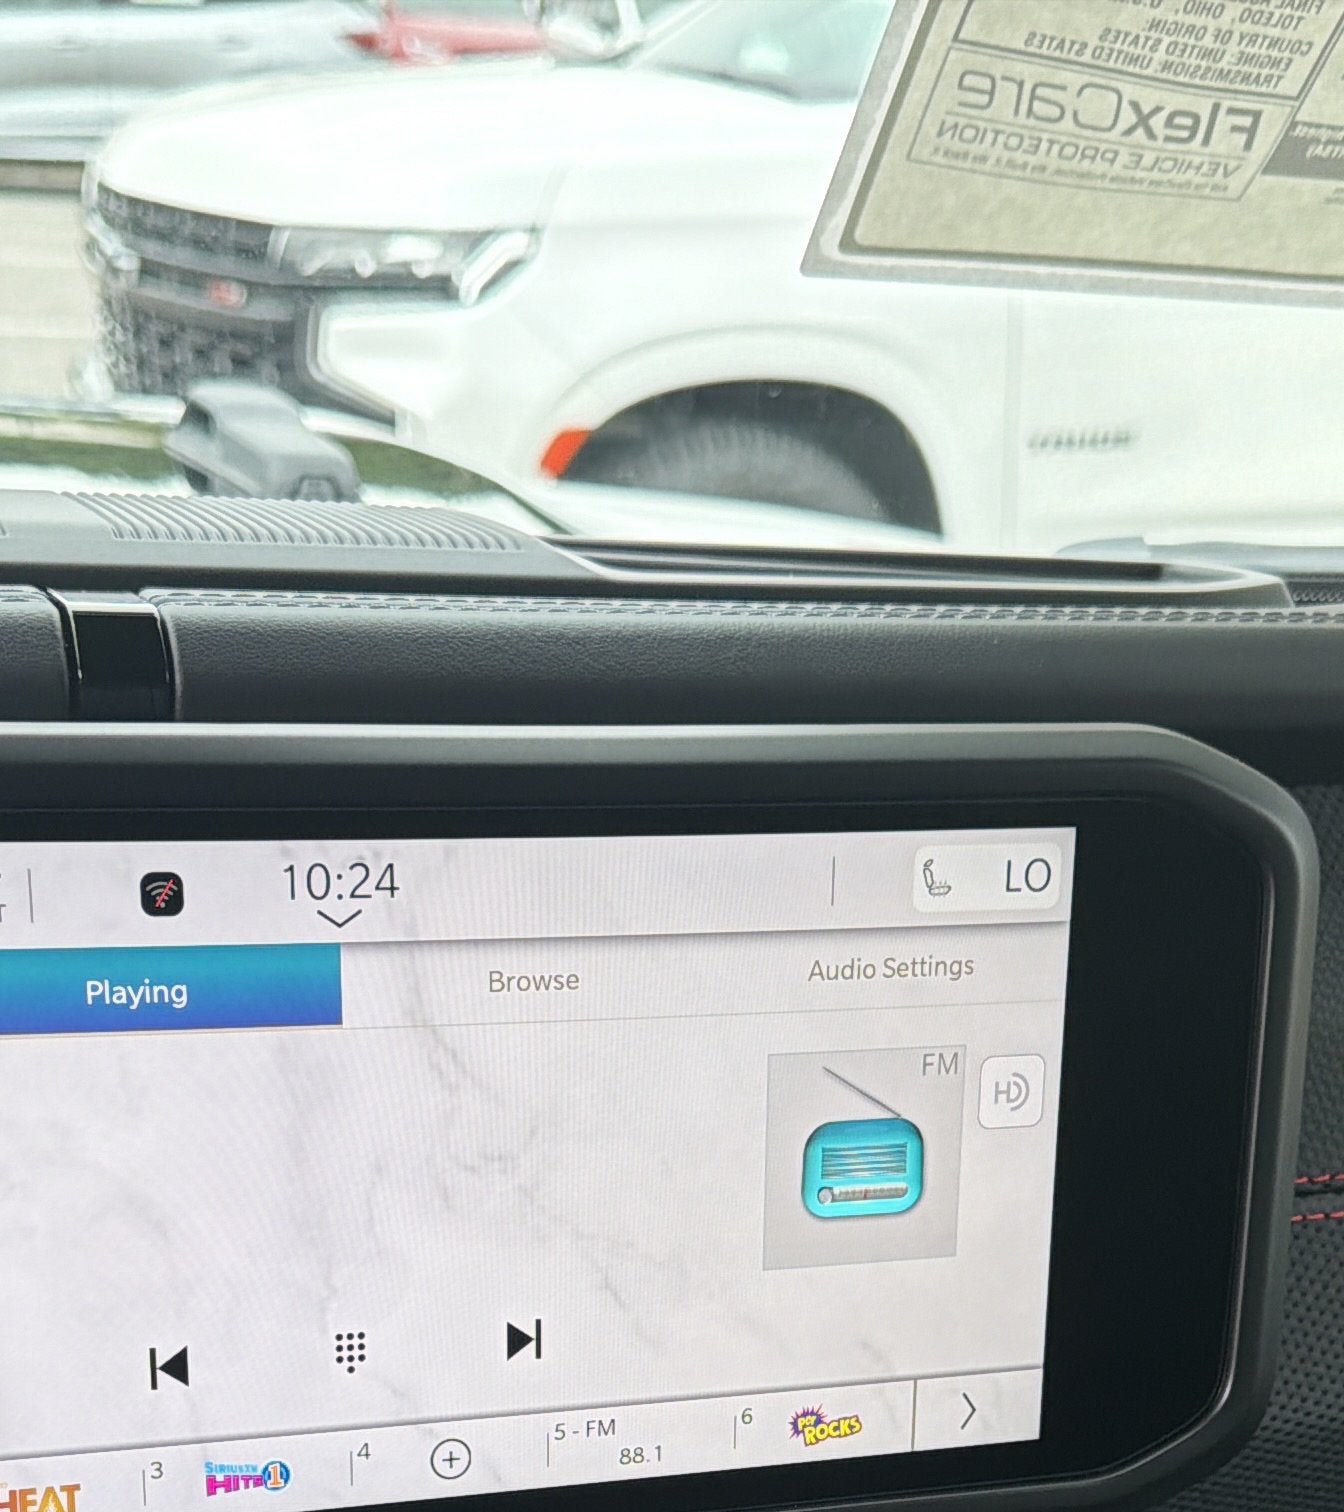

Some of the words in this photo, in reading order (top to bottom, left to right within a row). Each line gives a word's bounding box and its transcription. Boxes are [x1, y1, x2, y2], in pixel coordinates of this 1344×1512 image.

[283, 862, 400, 901] 10:24
[1005, 857, 1052, 893] LO
[808, 957, 877, 983] Audio
[882, 953, 975, 982] Settings
[488, 969, 580, 994] Browse
[86, 980, 188, 1010] Playing
[921, 1052, 959, 1077] FM
[742, 1408, 753, 1425] 6
[554, 1423, 566, 1441] 5
[586, 1418, 617, 1438] FM
[803, 1415, 862, 1447] ROCKS
[357, 1442, 371, 1461] 4
[619, 1445, 663, 1466] 88.1
[150, 1462, 164, 1479] 3
